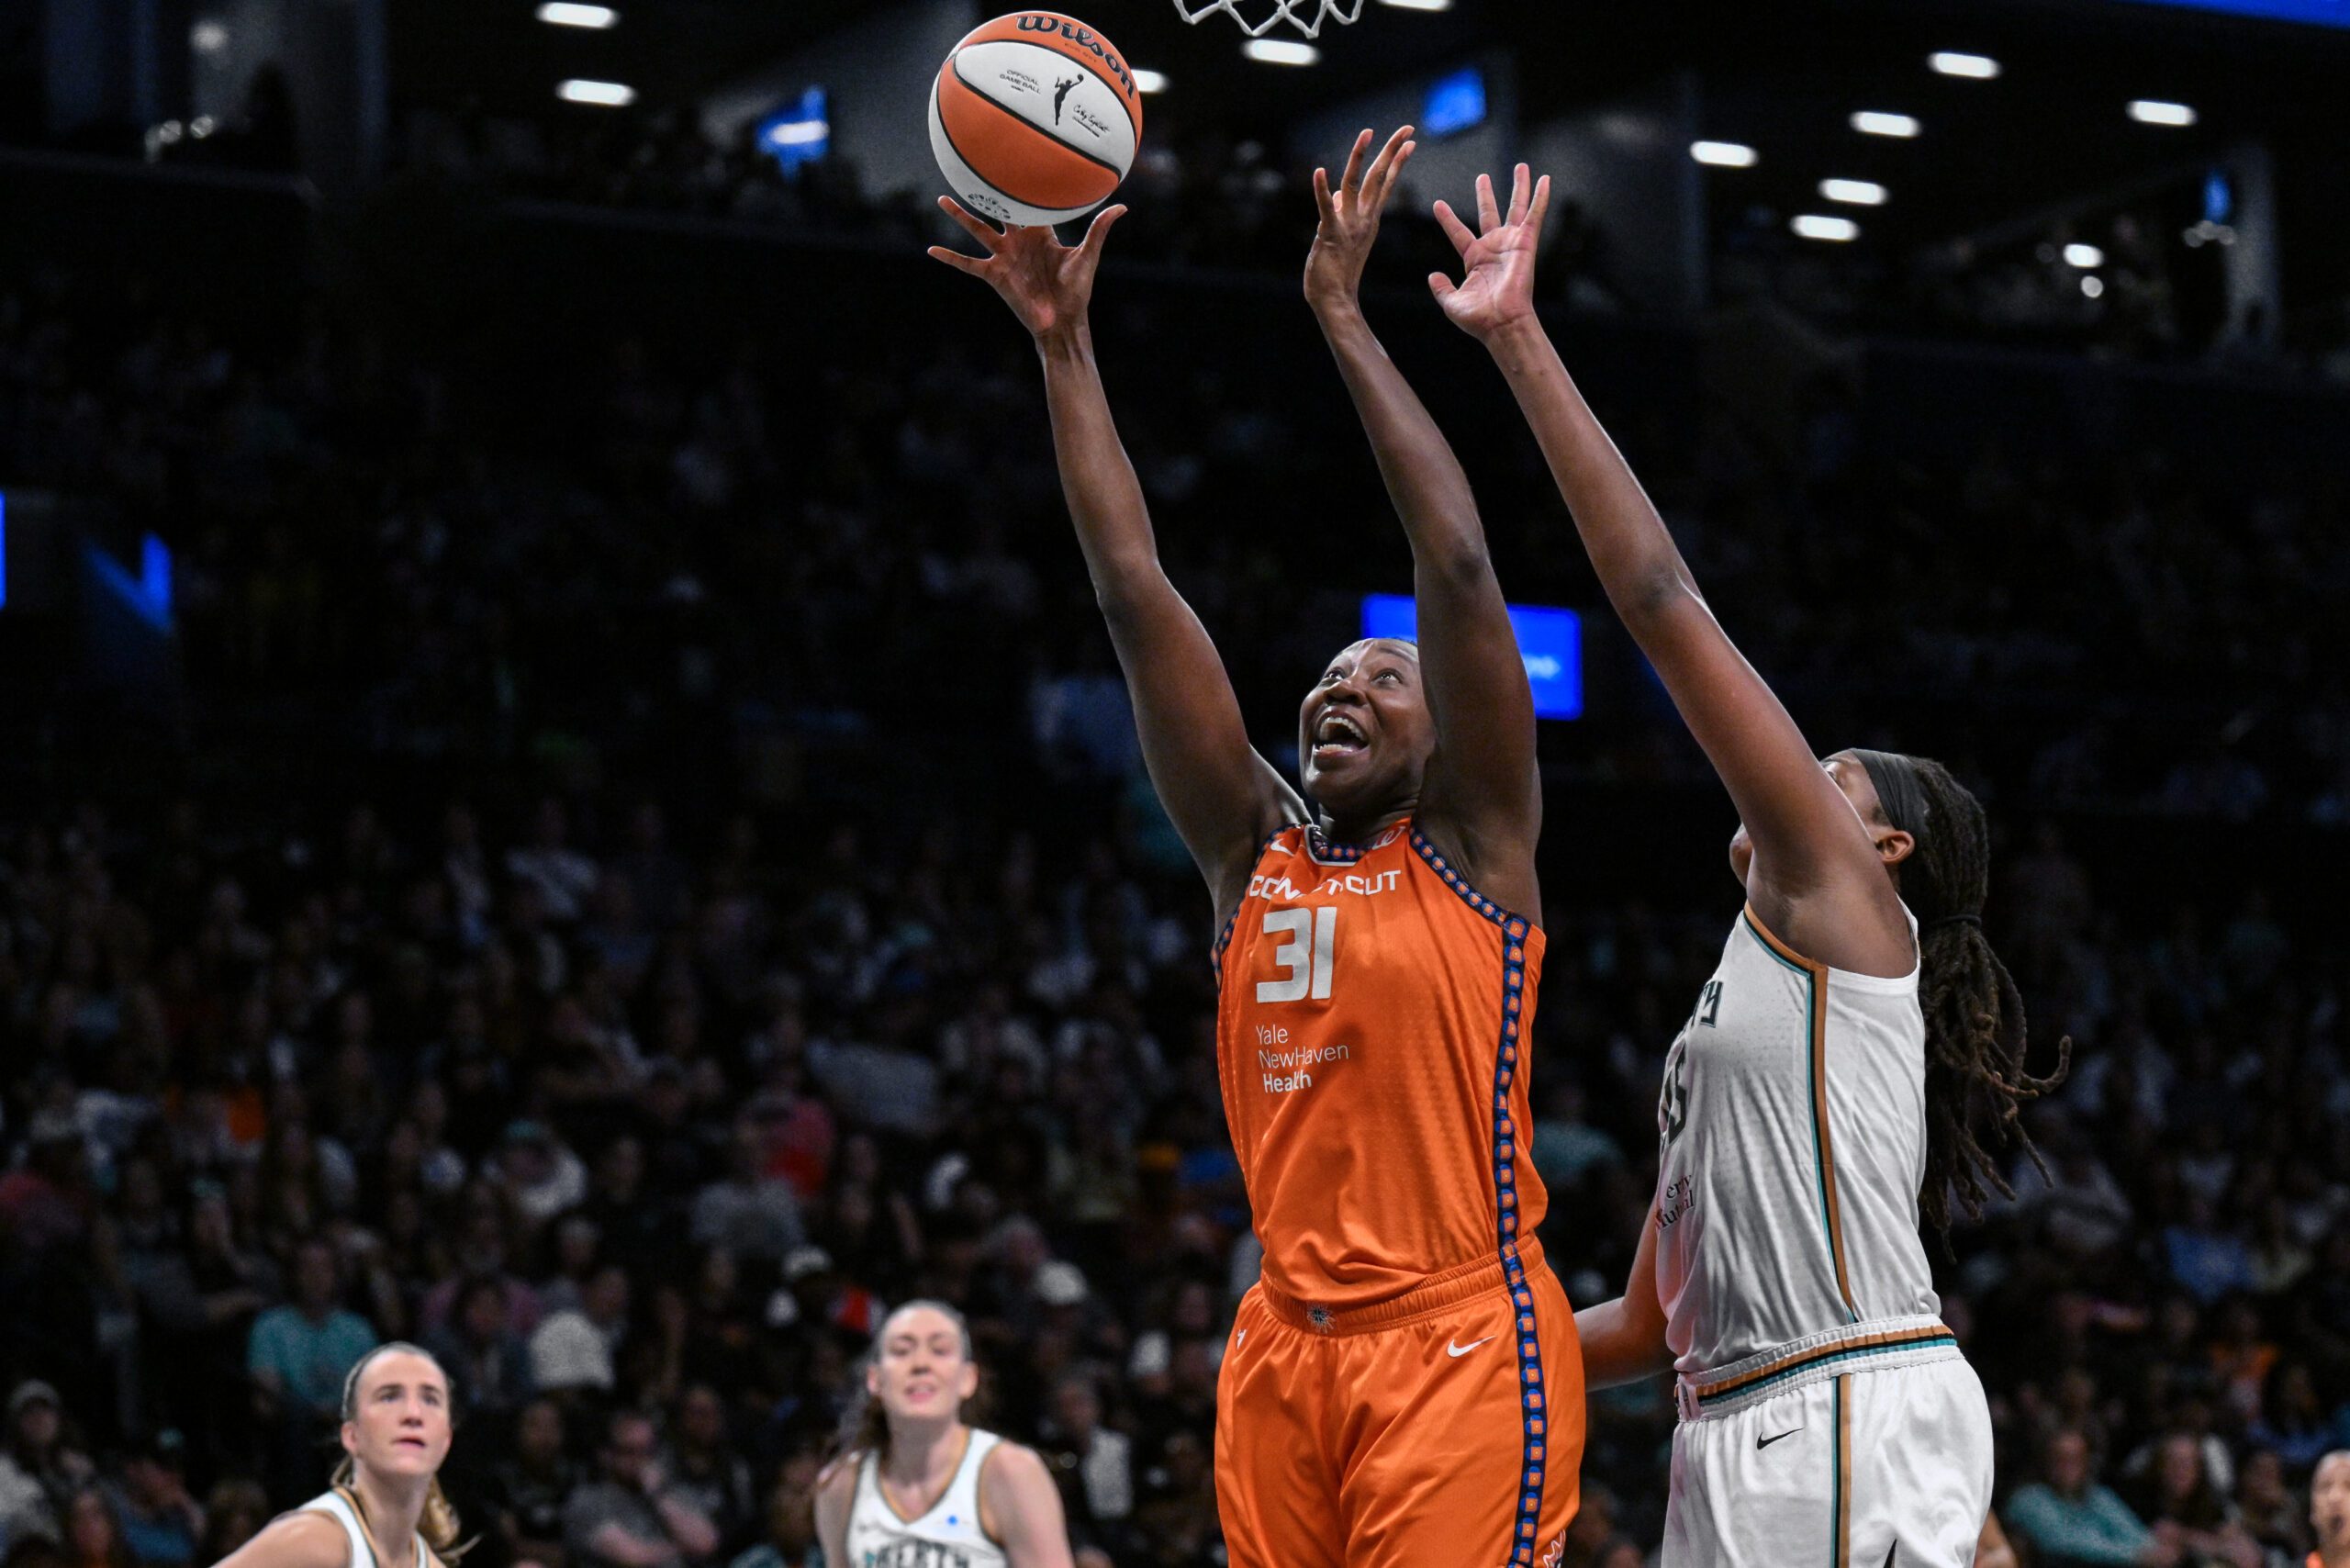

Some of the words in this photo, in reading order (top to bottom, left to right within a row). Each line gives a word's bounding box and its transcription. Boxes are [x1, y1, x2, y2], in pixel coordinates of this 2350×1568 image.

[1016, 16, 1136, 100] Wilson
[999, 73, 1021, 86] GAME
[1022, 81, 1041, 95] BALL
[1007, 69, 1039, 85] OFFICIAL
[1256, 906, 1337, 1003] 31
[1256, 1024, 1289, 1045] Yale
